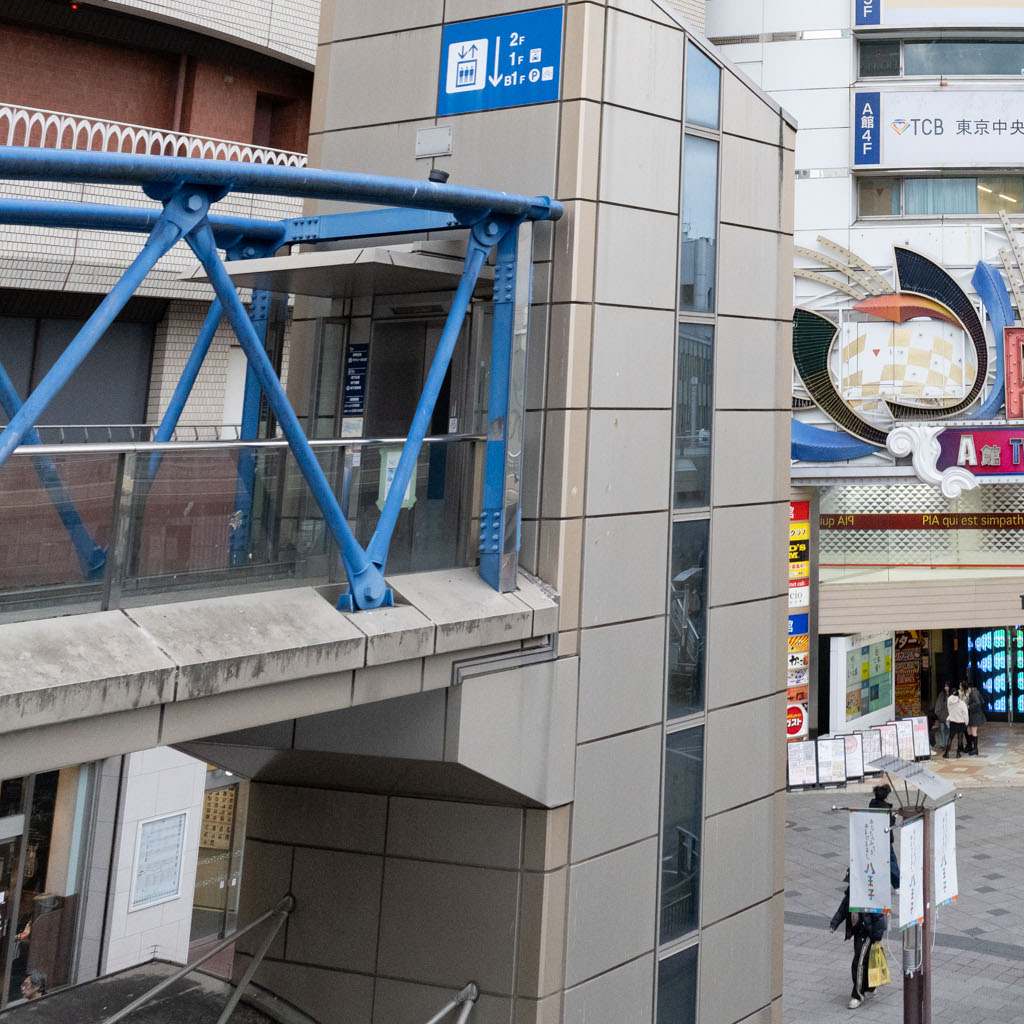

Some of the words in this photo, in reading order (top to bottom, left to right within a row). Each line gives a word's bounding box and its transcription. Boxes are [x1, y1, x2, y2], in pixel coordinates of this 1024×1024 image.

[509, 32, 525, 47] 2F
[509, 52, 524, 66] 1F
[504, 71, 526, 87] B1F
[910, 118, 944, 136] TCB
[923, 515, 939, 525] PIA
[942, 515, 958, 528] qui
[961, 516, 978, 526] est
[864, 862, 876, 901] 八王子
